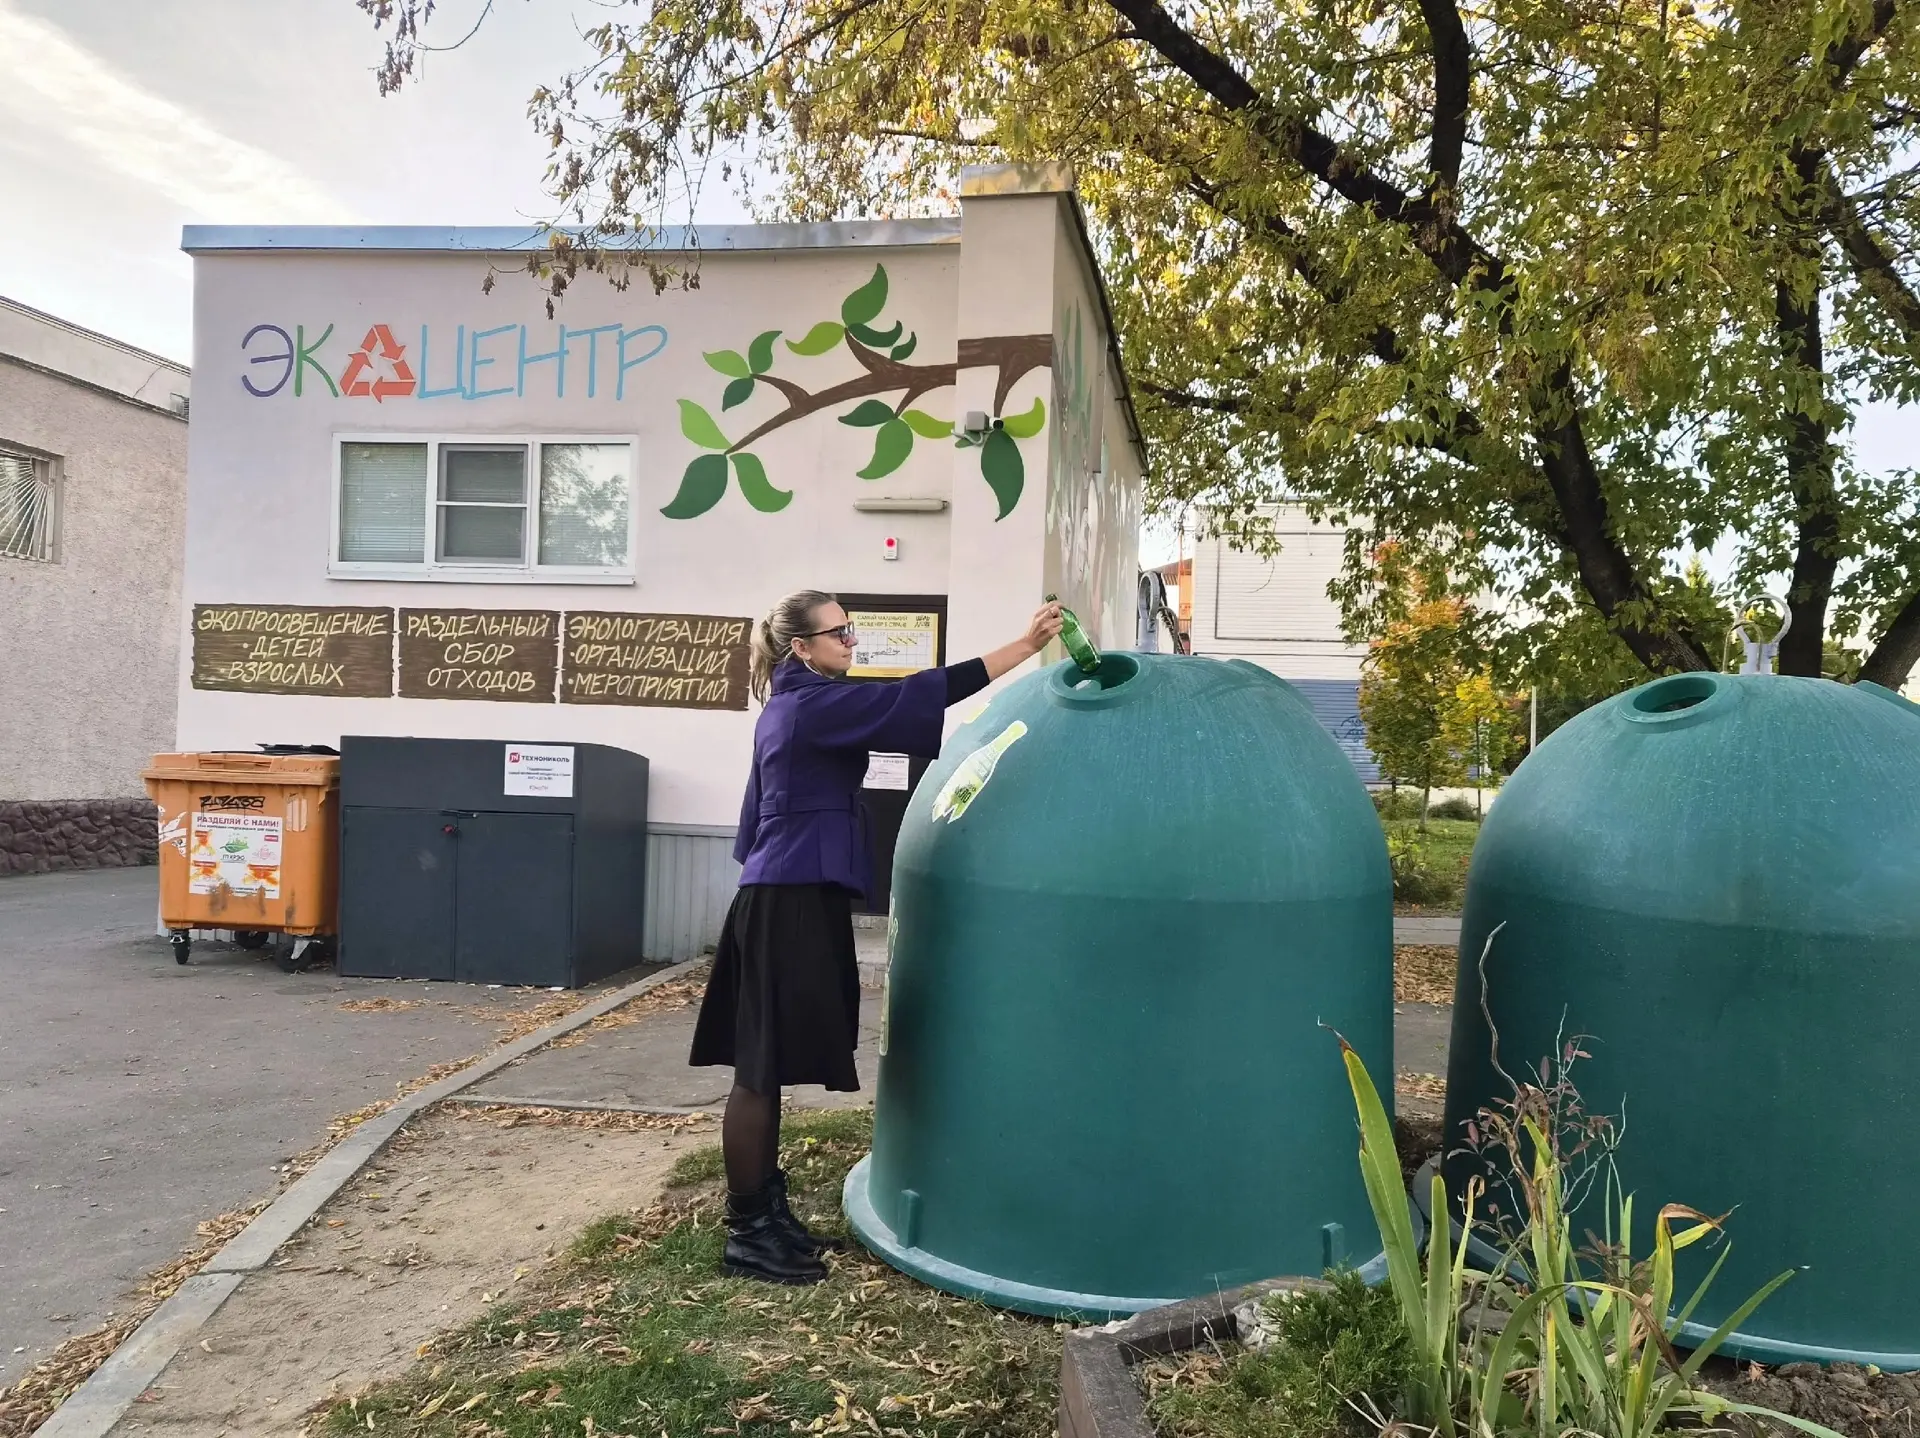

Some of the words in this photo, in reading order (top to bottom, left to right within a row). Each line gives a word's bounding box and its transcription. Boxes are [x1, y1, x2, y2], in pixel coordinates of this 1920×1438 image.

[197, 609, 389, 637] ЭКОПРОСВЕЩЕНИЕ
[406, 613, 551, 642] РАЗДЕЛЬНЫЙ
[568, 615, 746, 647] ЭКОЛОГИЗАЦИЯ
[249, 635, 325, 660] ДЕТЕЙ
[443, 642, 516, 666] СБОР
[575, 643, 731, 676] ОРГАНИЗАЦИЙ
[227, 661, 345, 687] ВЗРОСЛЫХ
[427, 667, 537, 693] ОТХОДОВ
[573, 672, 730, 702] МЕРОПРИЯТИЙ
[521, 755, 570, 763] ТЕХНОНИКОЛЬ
[197, 816, 241, 825] РАЗДЕЛЯЙ
[251, 820, 279, 828] НАМИ!
